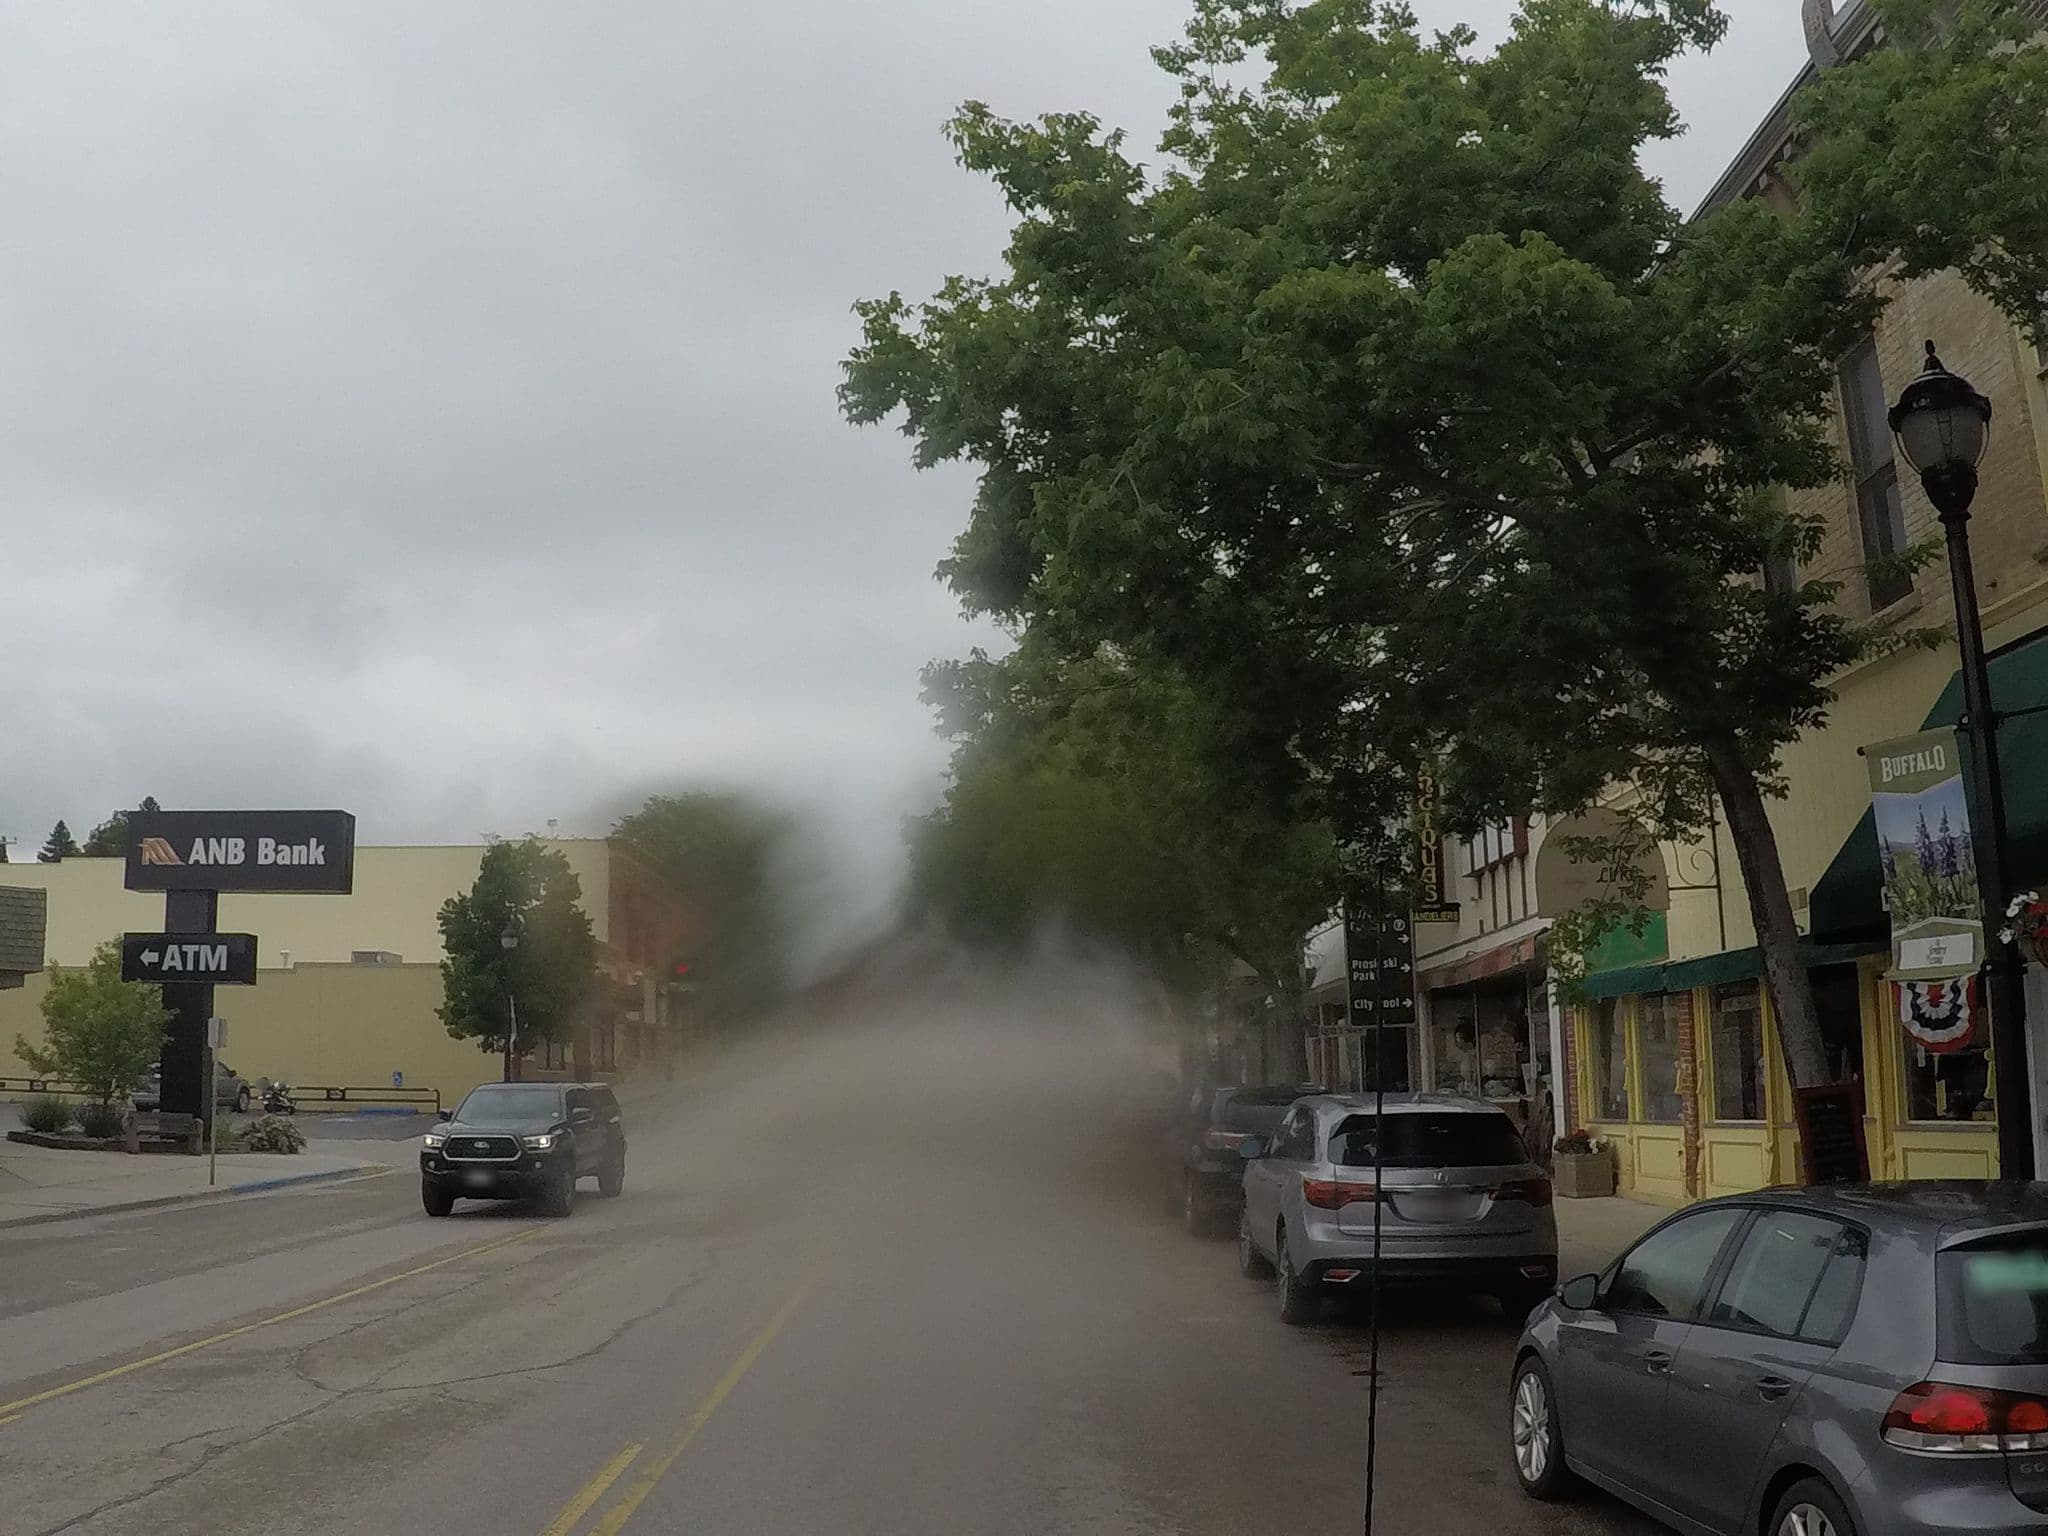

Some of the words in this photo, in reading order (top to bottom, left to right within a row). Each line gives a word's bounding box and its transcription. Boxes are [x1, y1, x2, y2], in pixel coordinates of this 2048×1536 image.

[1881, 745, 1946, 783] BUFFALO
[189, 837, 245, 864] ANB
[257, 837, 325, 865] Bank
[161, 945, 227, 971] ATM
[1352, 958, 1398, 969] Prosiski
[1353, 970, 1376, 981] Park
[1354, 998, 1374, 1011] City
[1381, 998, 1400, 1008] ool
